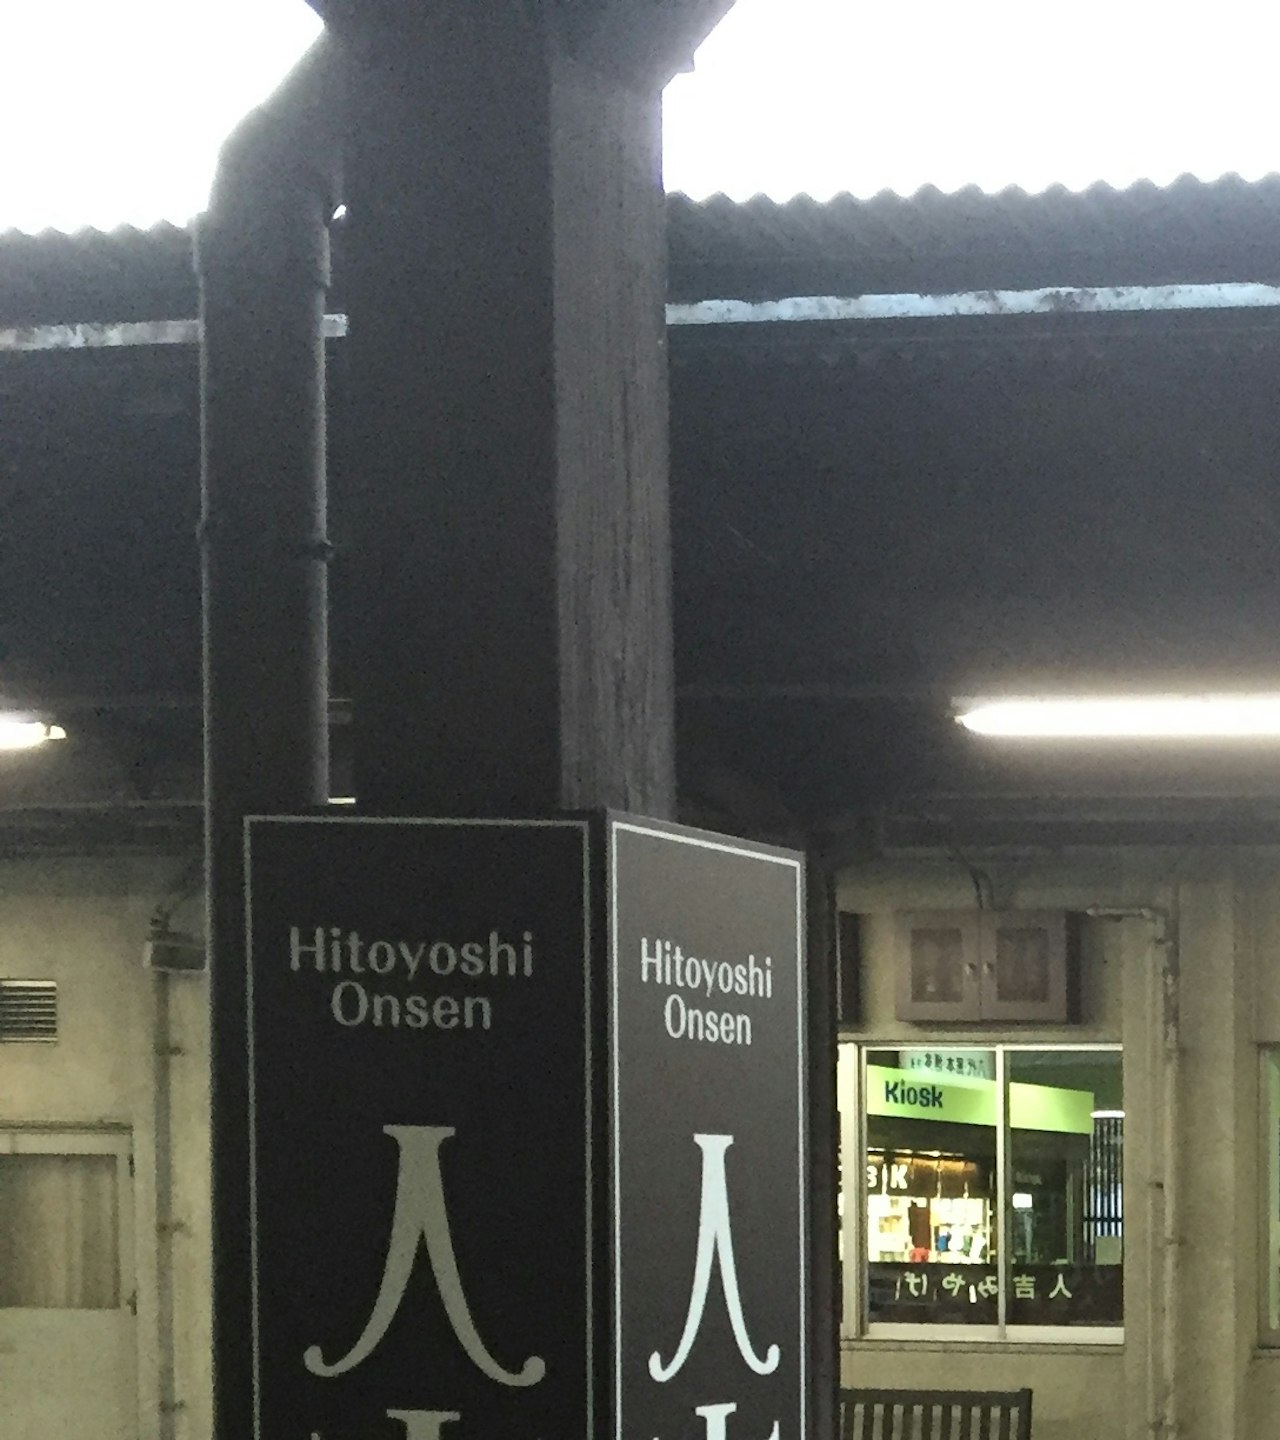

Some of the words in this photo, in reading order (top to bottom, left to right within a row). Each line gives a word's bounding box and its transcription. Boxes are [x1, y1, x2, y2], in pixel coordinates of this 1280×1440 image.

[290, 927, 534, 978] Hitoyoshi
[640, 938, 774, 999] Hitoyoshi
[330, 981, 493, 1030] Onsen
[664, 995, 752, 1045] Onsen
[884, 1079, 944, 1109] Kiosk
